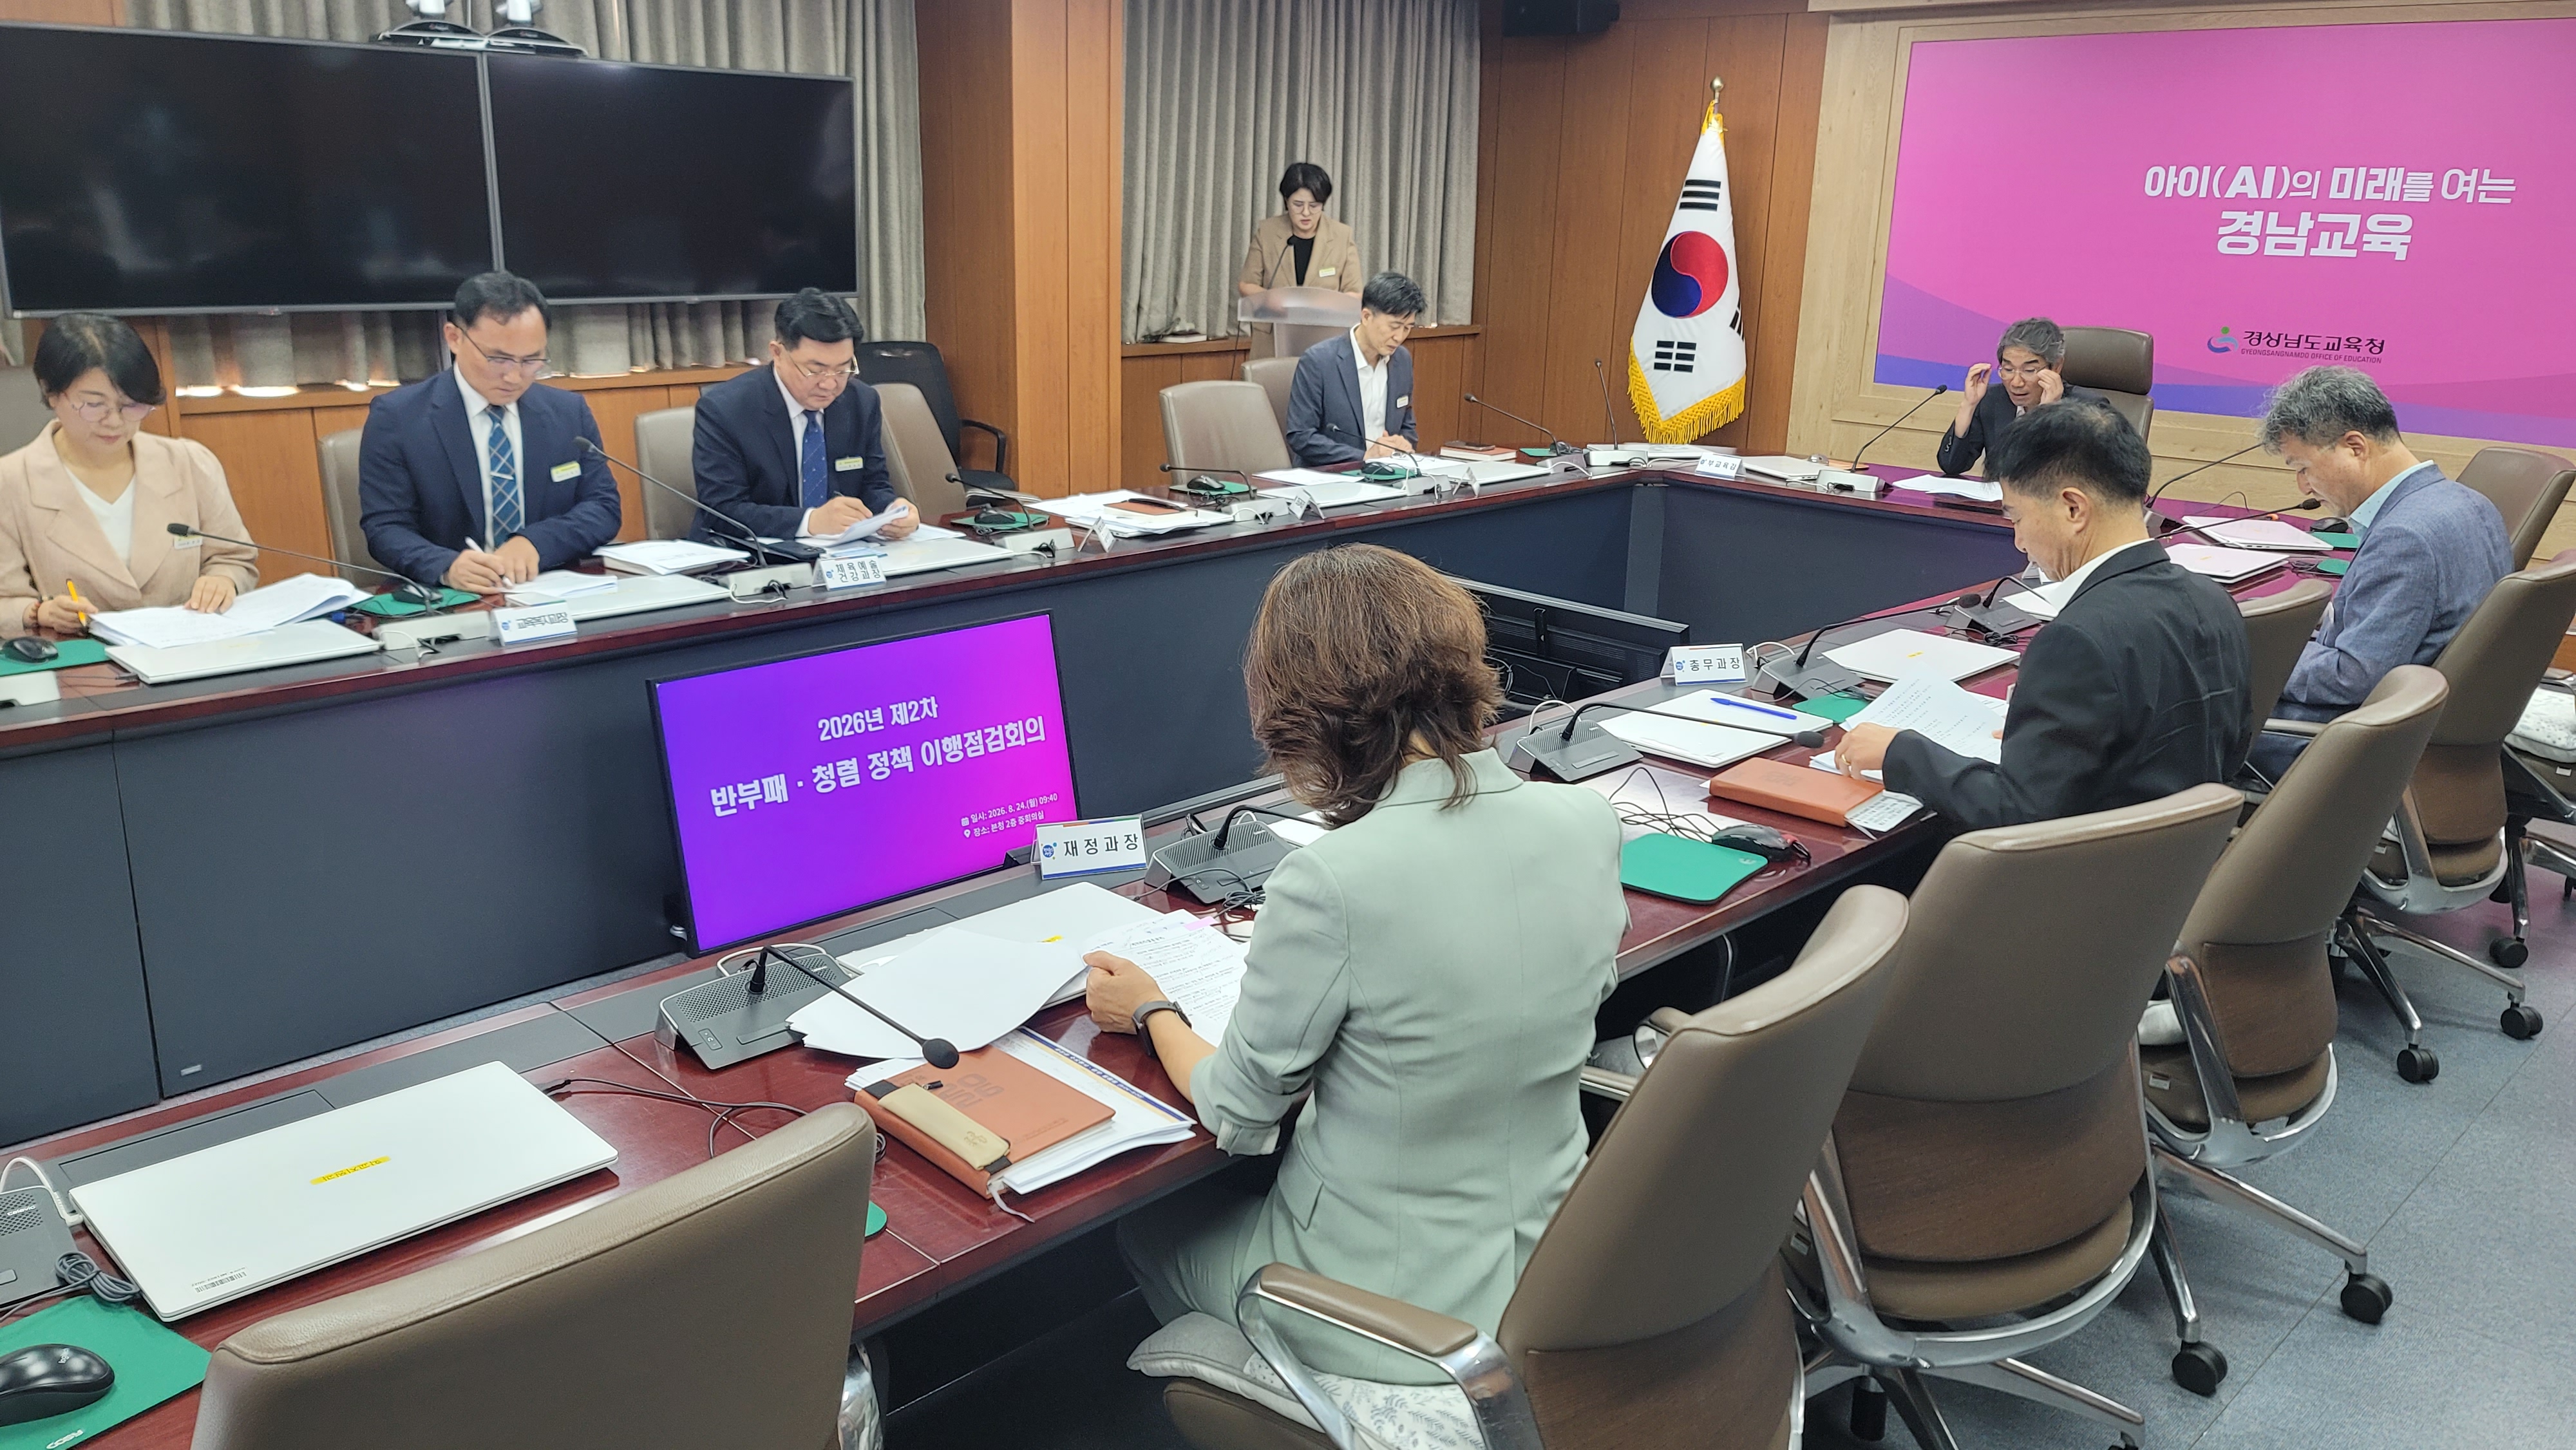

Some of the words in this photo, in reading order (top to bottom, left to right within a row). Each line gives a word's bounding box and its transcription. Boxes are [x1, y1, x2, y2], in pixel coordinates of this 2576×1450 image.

[2145, 165, 2321, 199] 아이(AI)의
[2329, 166, 2434, 202] 미래를
[2441, 167, 2516, 203] 여는
[2217, 210, 2413, 261] 경남교육
[2243, 330, 2385, 355] 경상남도교육청
[2241, 348, 2309, 359] GYEONGSANGNAMDO
[2343, 355, 2382, 364] EDUCATION
[835, 560, 877, 573] 체육예술
[838, 569, 881, 583] 건강과장
[1689, 657, 1740, 672] 총무과장
[817, 707, 884, 741] 2026년
[889, 696, 938, 726] 제2차
[710, 773, 789, 817] 반부패
[811, 757, 860, 793] 청렴
[867, 745, 914, 780] 정책
[920, 715, 1046, 766] 이행점검회의
[971, 813, 987, 824] 일시:
[988, 806, 1008, 818] 2026.
[1039, 793, 1058, 805] 09:40
[973, 827, 990, 837] 장소:
[990, 821, 1005, 833] 본청
[1005, 818, 1017, 828] 2층
[1018, 810, 1045, 825] 중회의실
[1063, 833, 1139, 857] 재정과장
